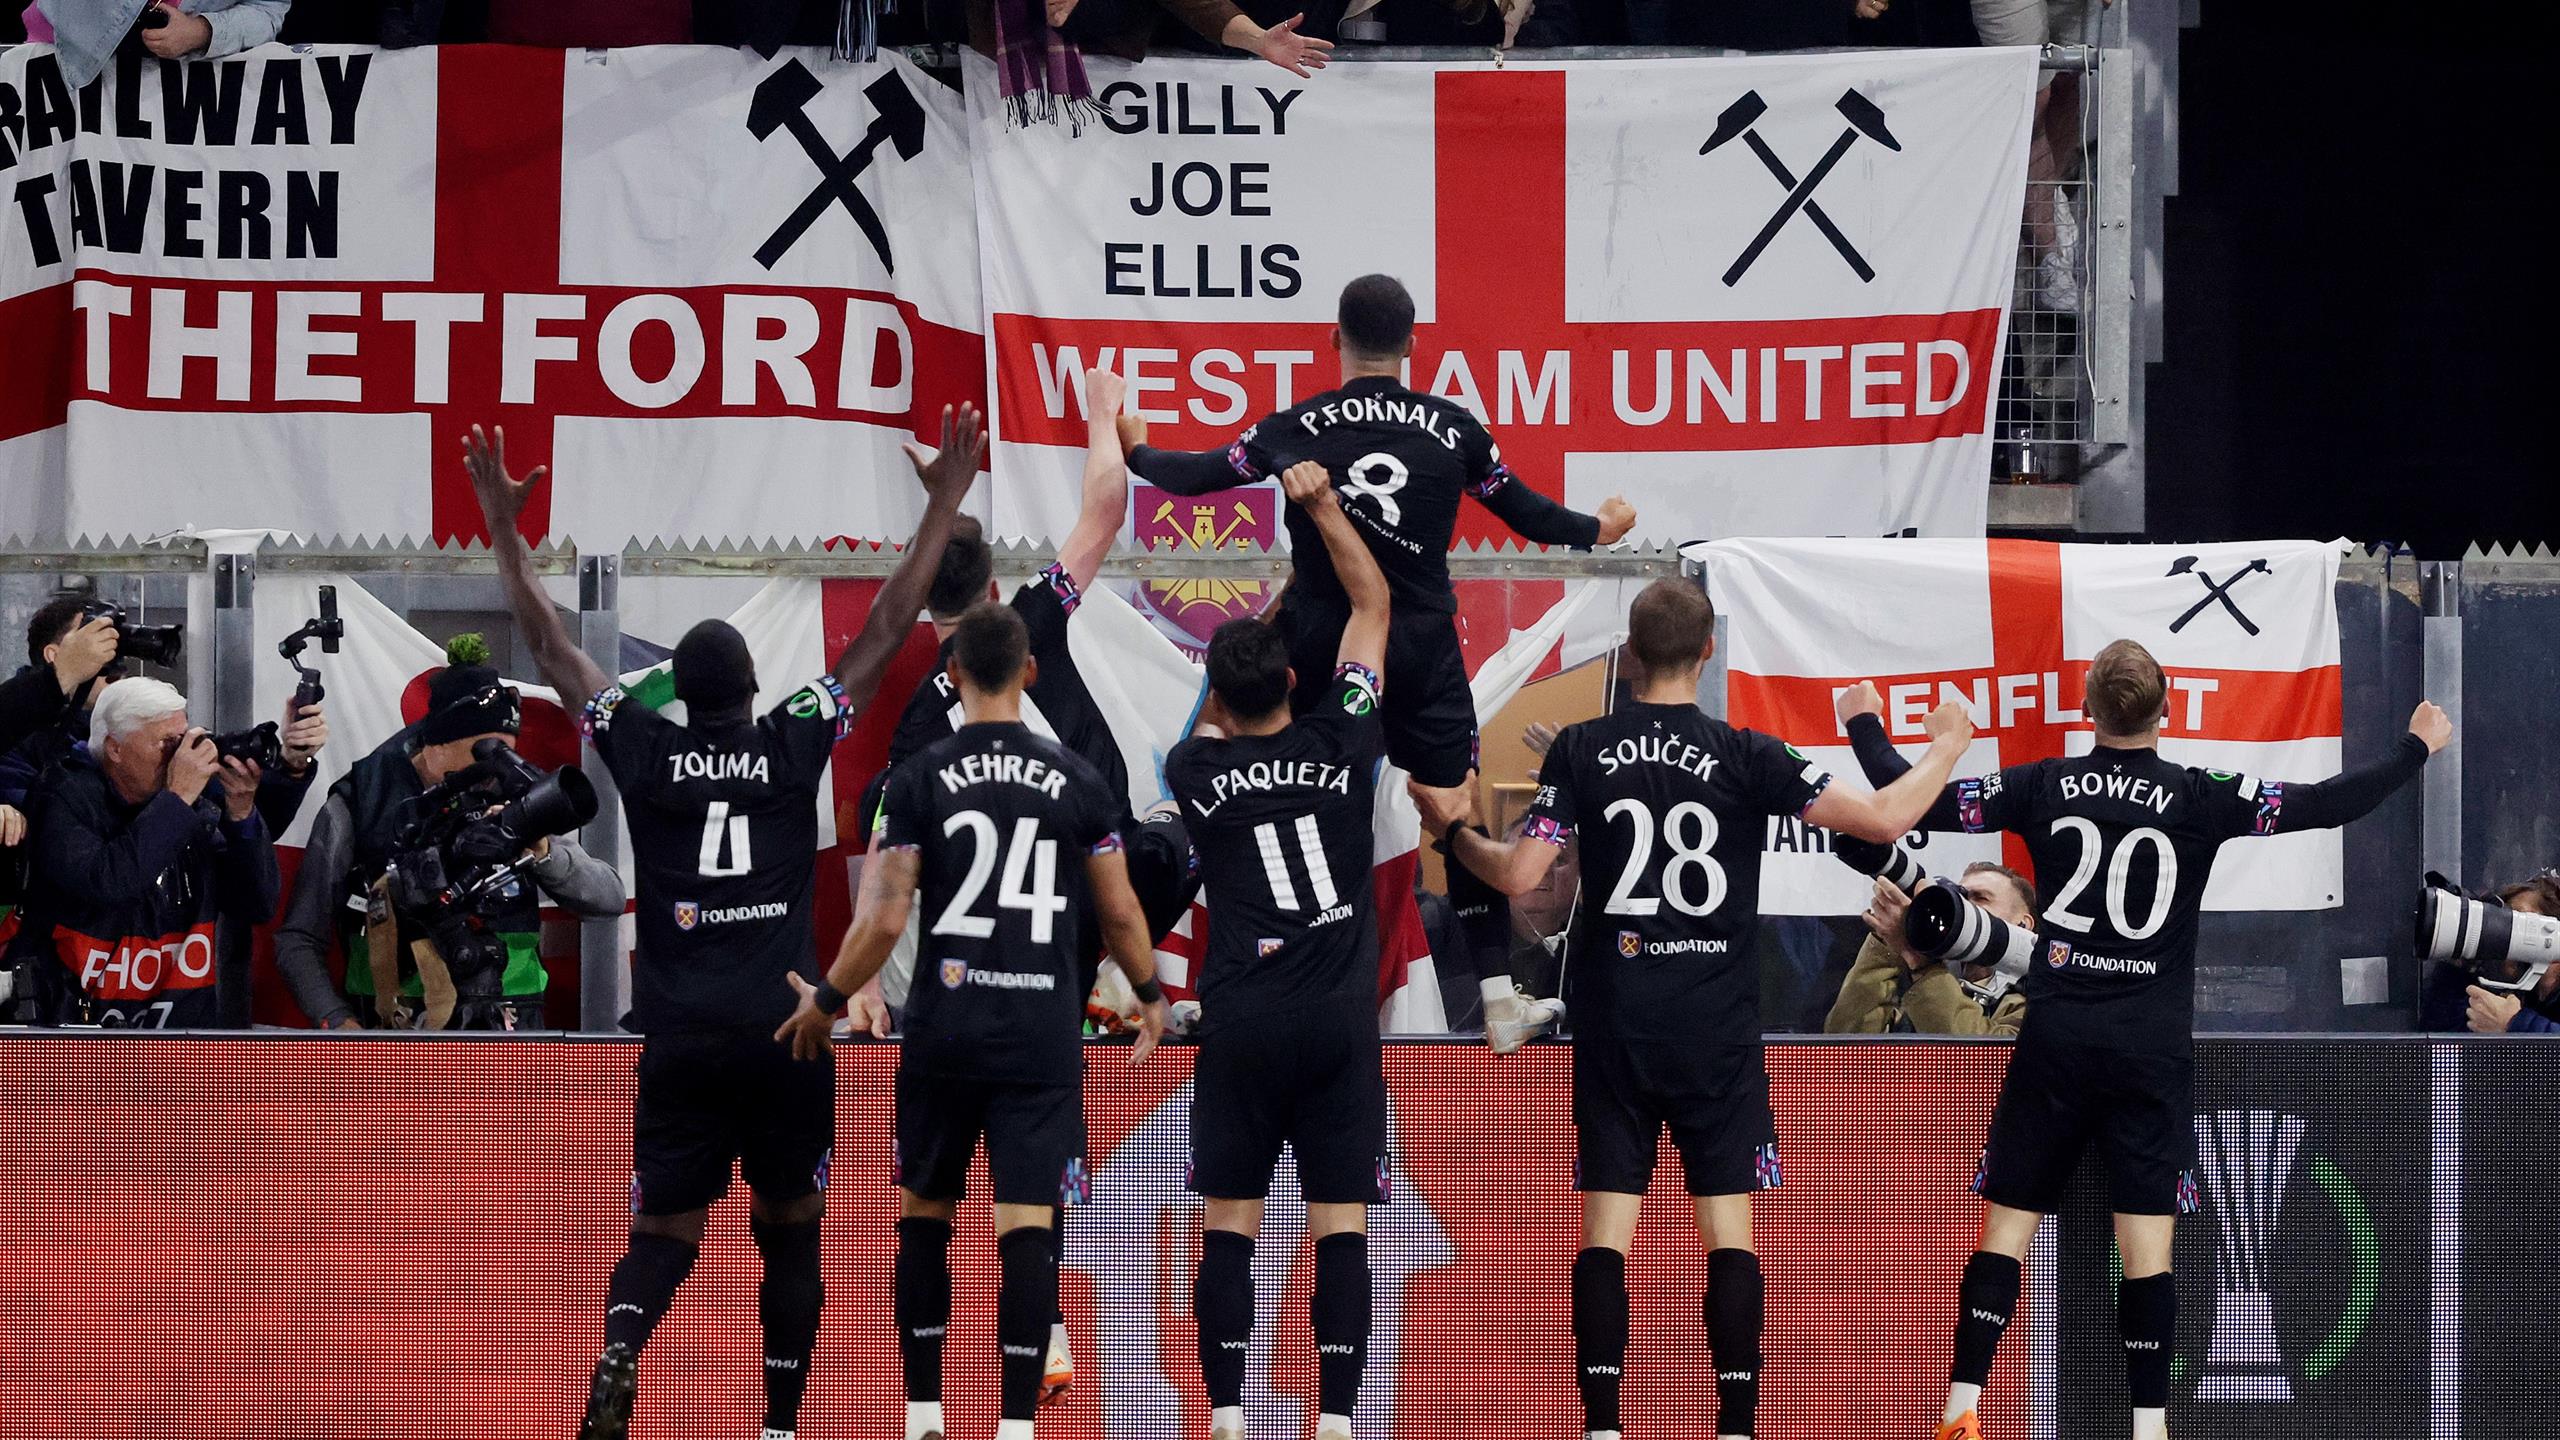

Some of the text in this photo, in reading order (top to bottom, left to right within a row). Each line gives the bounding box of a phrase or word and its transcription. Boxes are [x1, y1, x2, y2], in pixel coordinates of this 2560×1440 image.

[1100, 81, 1303, 135] GILLY
[14, 158, 340, 268] TAVERN
[1130, 162, 1271, 217] JOE
[1105, 243, 1301, 298] ELLIS
[73, 279, 914, 415] THETFORD
[1031, 339, 1970, 426] WEST AM UNITED
[1300, 397, 1461, 450] P.FORNALS
[1339, 452, 1409, 527] 8
[1832, 671, 2219, 737] ENFLT
[669, 751, 769, 784] ZOUMA
[939, 753, 1067, 800] KEHRER
[1598, 734, 1719, 782] SOUČEK
[1191, 759, 1351, 818] L.PAQUETÁ
[2060, 772, 2174, 815] BOWEN
[699, 801, 752, 877] 4
[1254, 813, 1339, 911] 11
[1603, 798, 1728, 917] 28
[931, 809, 1068, 944] 24
[2042, 815, 2178, 940] 20
[702, 902, 788, 923] FOUNDATION
[81, 933, 211, 992] PHOTO
[1645, 939, 1728, 956] FOUNDATION
[2072, 951, 2157, 975] FOUNDATION
[967, 968, 1055, 991] FOUNDATION
[1972, 1307, 2006, 1326] WHU
[765, 1356, 798, 1369] WHU
[1320, 1344, 1354, 1355] WHU
[1586, 1365, 1620, 1375] WHU
[2125, 1340, 2160, 1350] WHU
[1719, 1371, 1751, 1381] WHU
